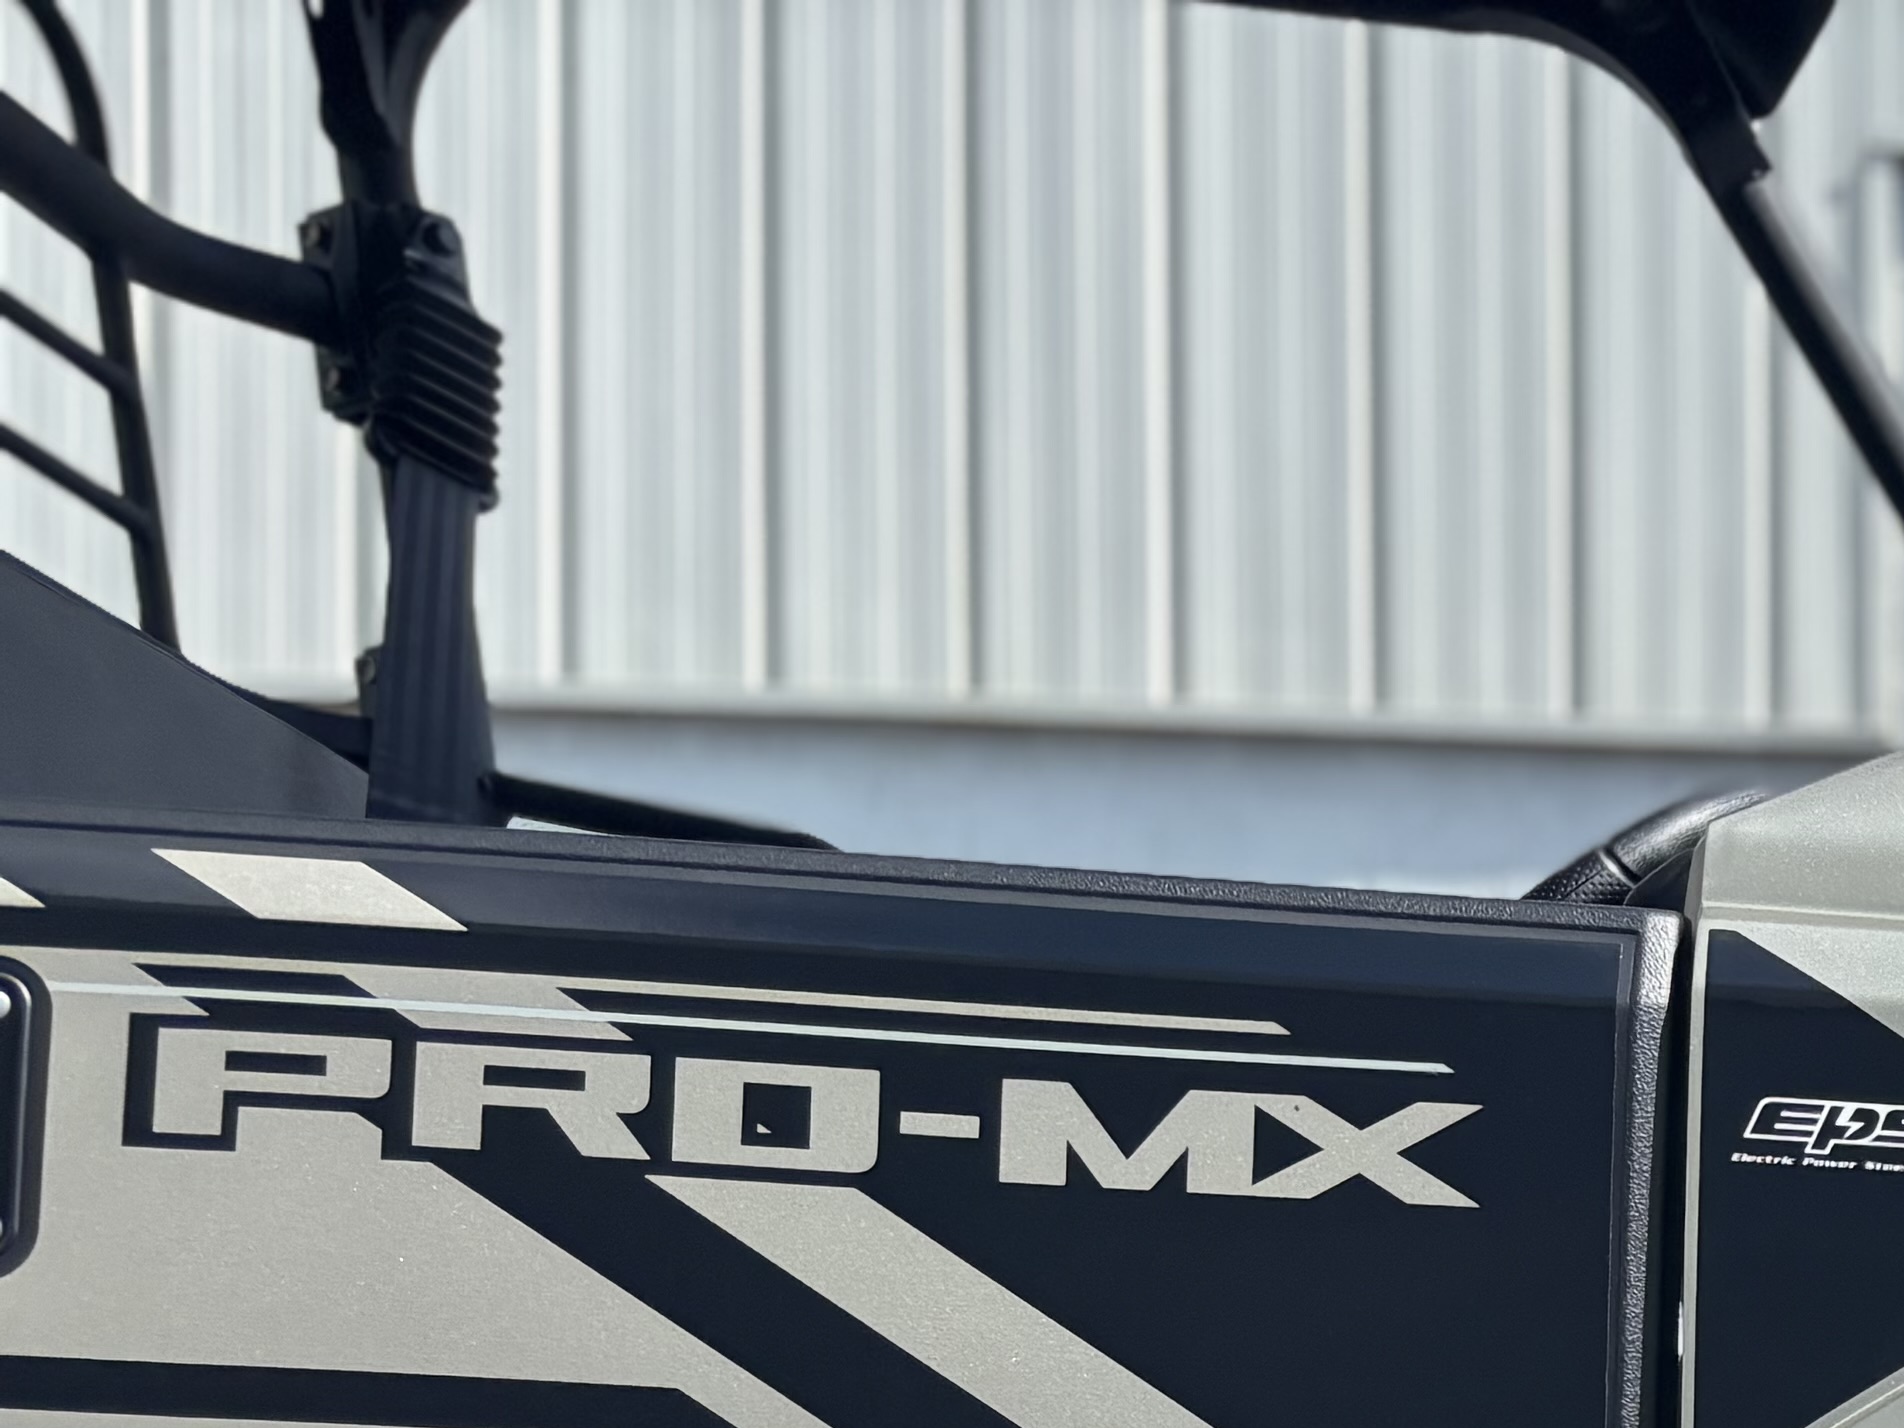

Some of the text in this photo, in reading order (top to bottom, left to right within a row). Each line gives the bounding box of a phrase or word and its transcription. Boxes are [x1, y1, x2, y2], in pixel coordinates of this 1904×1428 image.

[152, 1025, 1484, 1207] PRO-MX
[1731, 1152, 1796, 1167] Electric
[1802, 1157, 1857, 1170] Power
